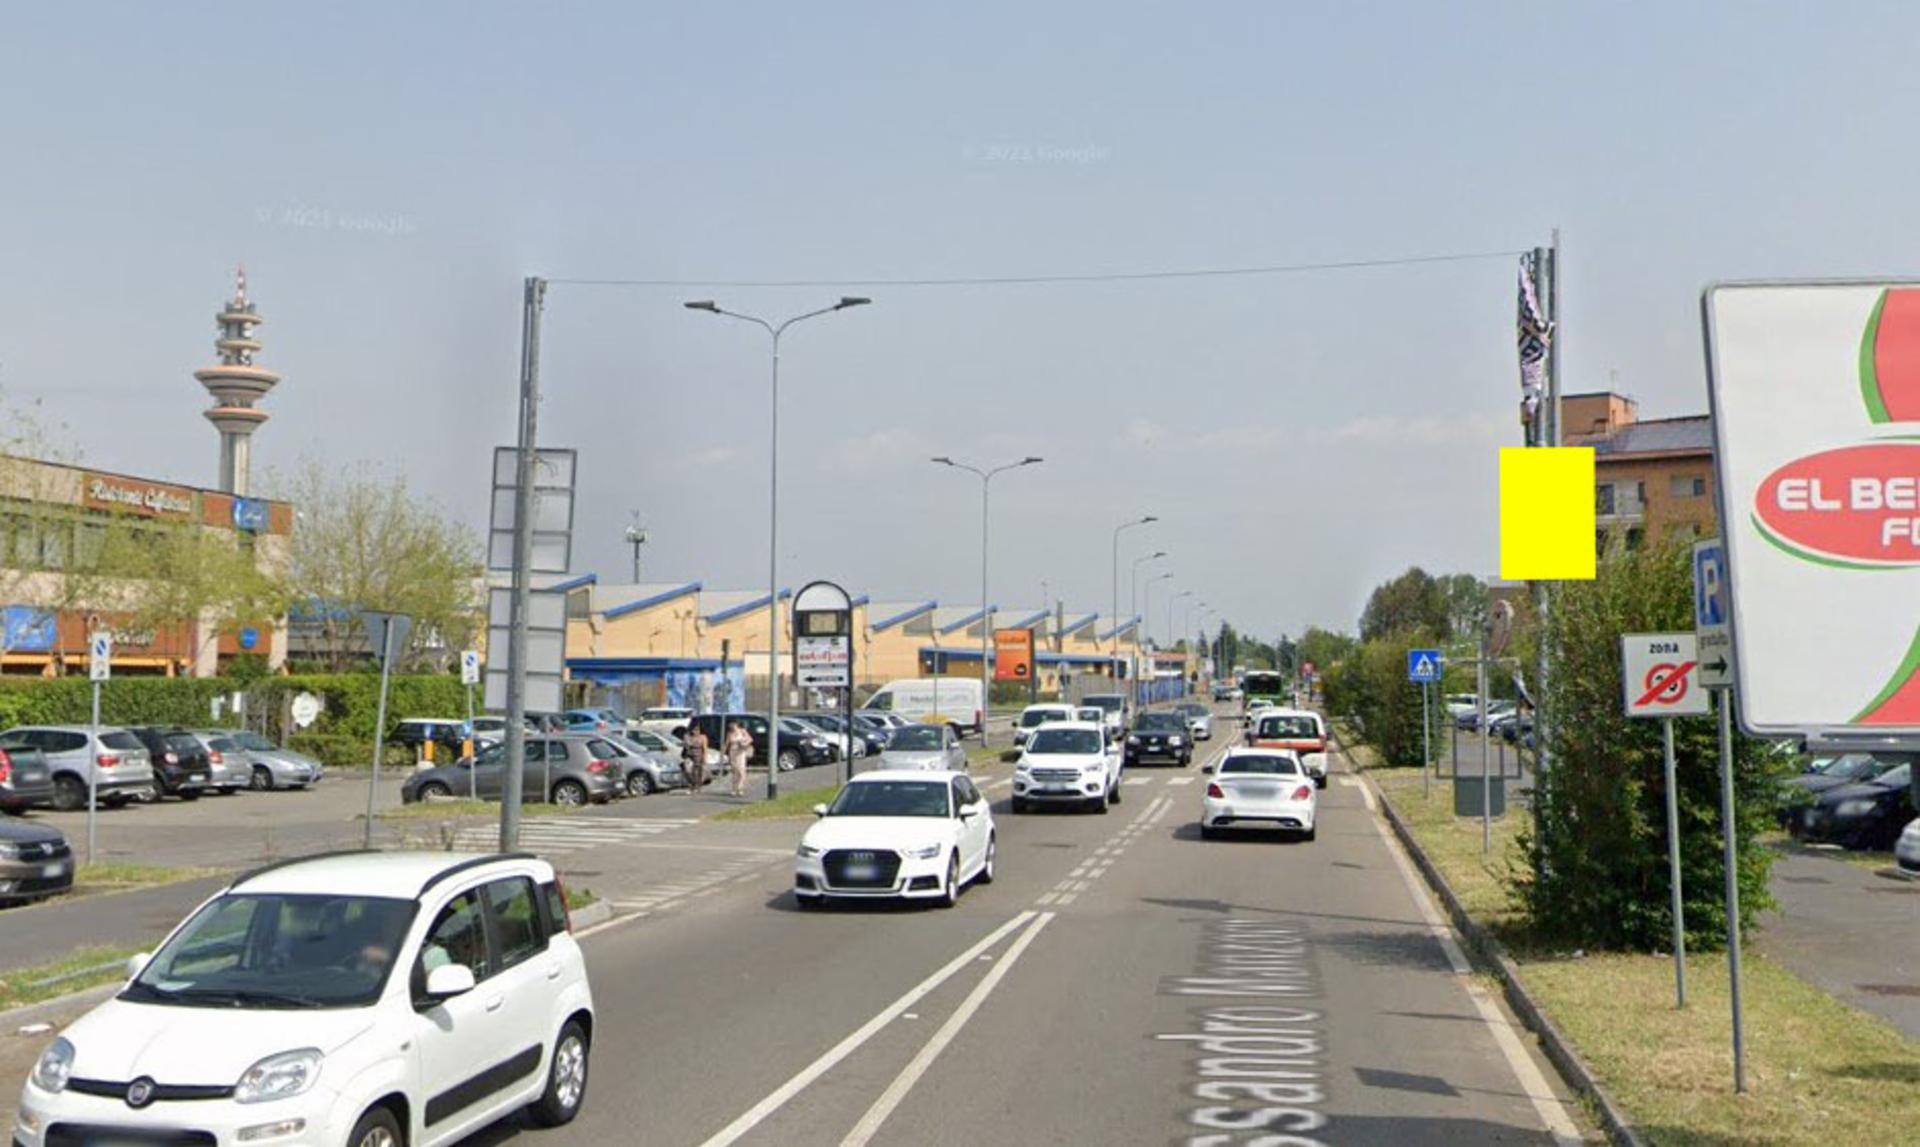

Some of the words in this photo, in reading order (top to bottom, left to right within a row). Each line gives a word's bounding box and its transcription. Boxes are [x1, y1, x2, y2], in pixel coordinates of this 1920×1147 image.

[1777, 477, 1841, 511] EL
[1850, 477, 1920, 511] BE
[1702, 559, 1719, 616] P
